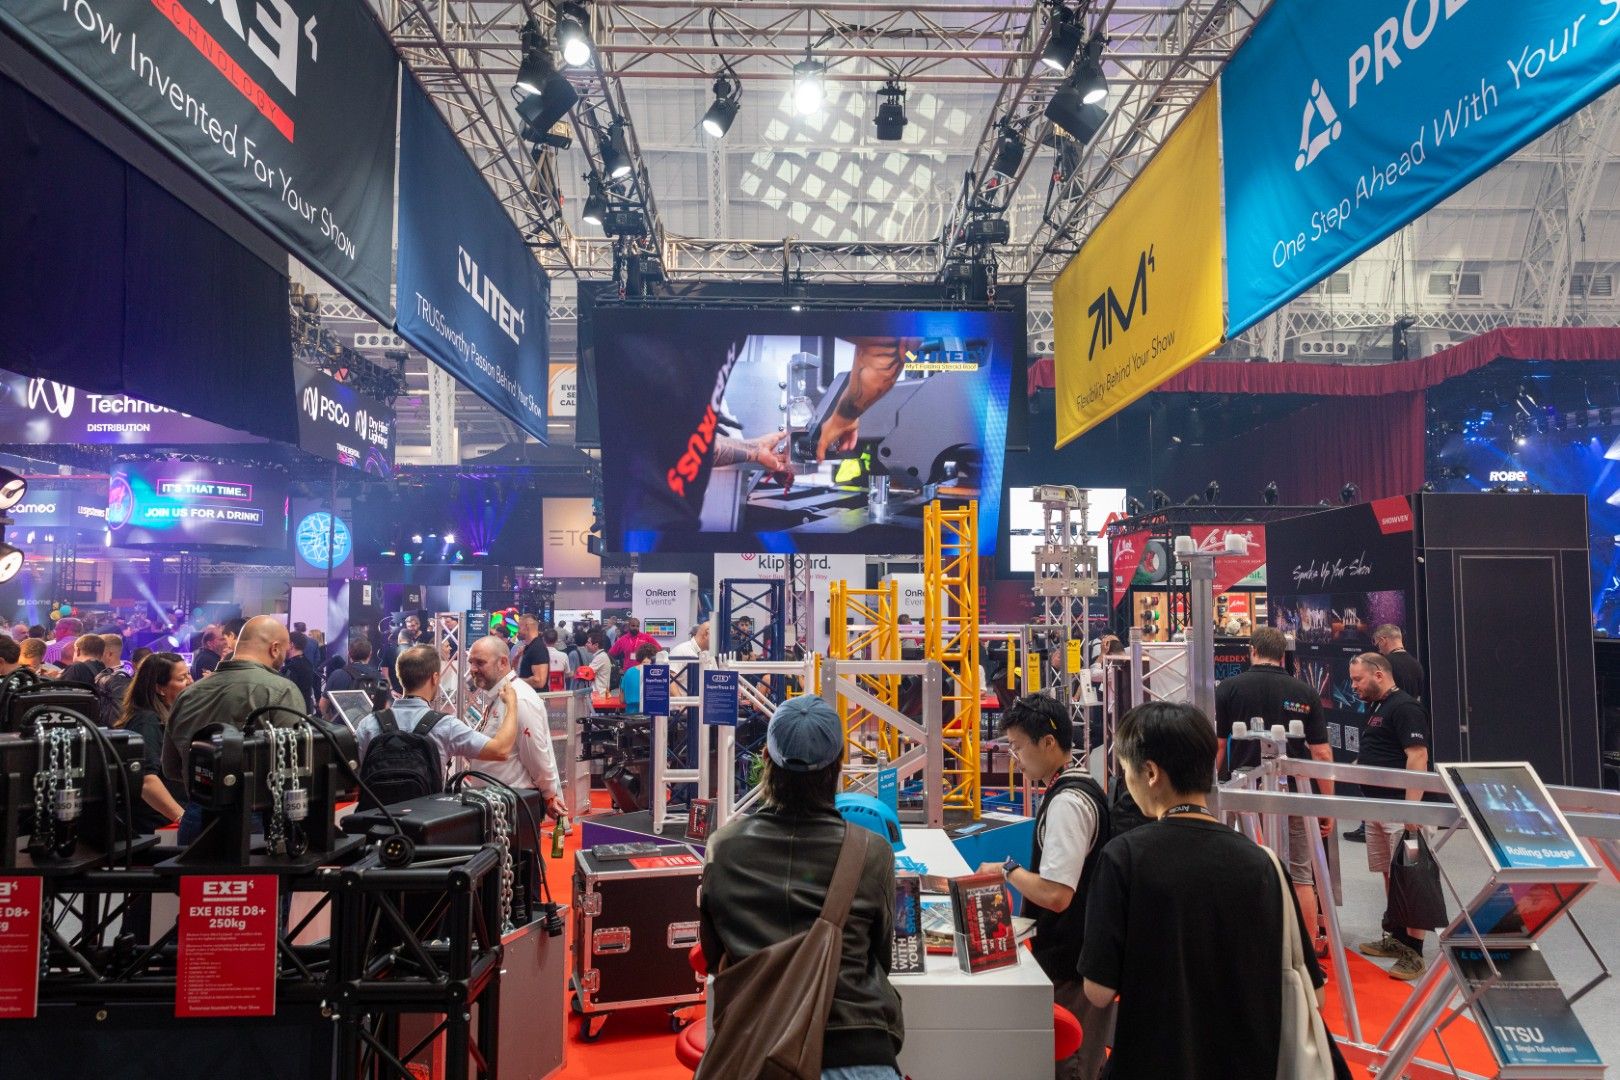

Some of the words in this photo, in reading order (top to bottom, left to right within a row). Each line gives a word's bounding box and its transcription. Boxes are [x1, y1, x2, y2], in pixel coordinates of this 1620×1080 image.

[131, 32, 238, 158] Invented
[243, 137, 274, 188] For
[279, 168, 318, 225] Your
[320, 206, 355, 260] Show
[1272, 231, 1306, 268] One
[1310, 198, 1351, 242] Step
[1355, 126, 1425, 209] Ahead
[1433, 78, 1499, 148] With
[1507, 14, 1587, 90] Your
[1105, 358, 1131, 391] Behind
[1131, 349, 1150, 372] Your
[1151, 330, 1176, 360] Show
[470, 342, 497, 380] Passion
[495, 365, 517, 397] Behind
[320, 395, 349, 428] PSCo
[87, 423, 150, 432] DISTRIBUTION
[368, 431, 388, 449] Lighting
[162, 483, 182, 495] IT'S
[185, 484, 215, 496] THAT
[144, 506, 170, 518] JOIN
[172, 507, 188, 518] US
[190, 509, 215, 519] FOR
[217, 510, 225, 519] A
[226, 511, 259, 522] DRINK!
[645, 588, 677, 597] OnRent
[904, 589, 926, 597] OnR
[1505, 846, 1543, 859] Rolling
[1541, 848, 1575, 860] Stage
[5, 907, 31, 917] D8+
[189, 906, 213, 917] EXE
[214, 906, 240, 916] RISE
[242, 906, 267, 917] D8+
[209, 919, 246, 931] 250kg
[898, 938, 908, 970] WITH
[907, 935, 919, 970] YOUR
